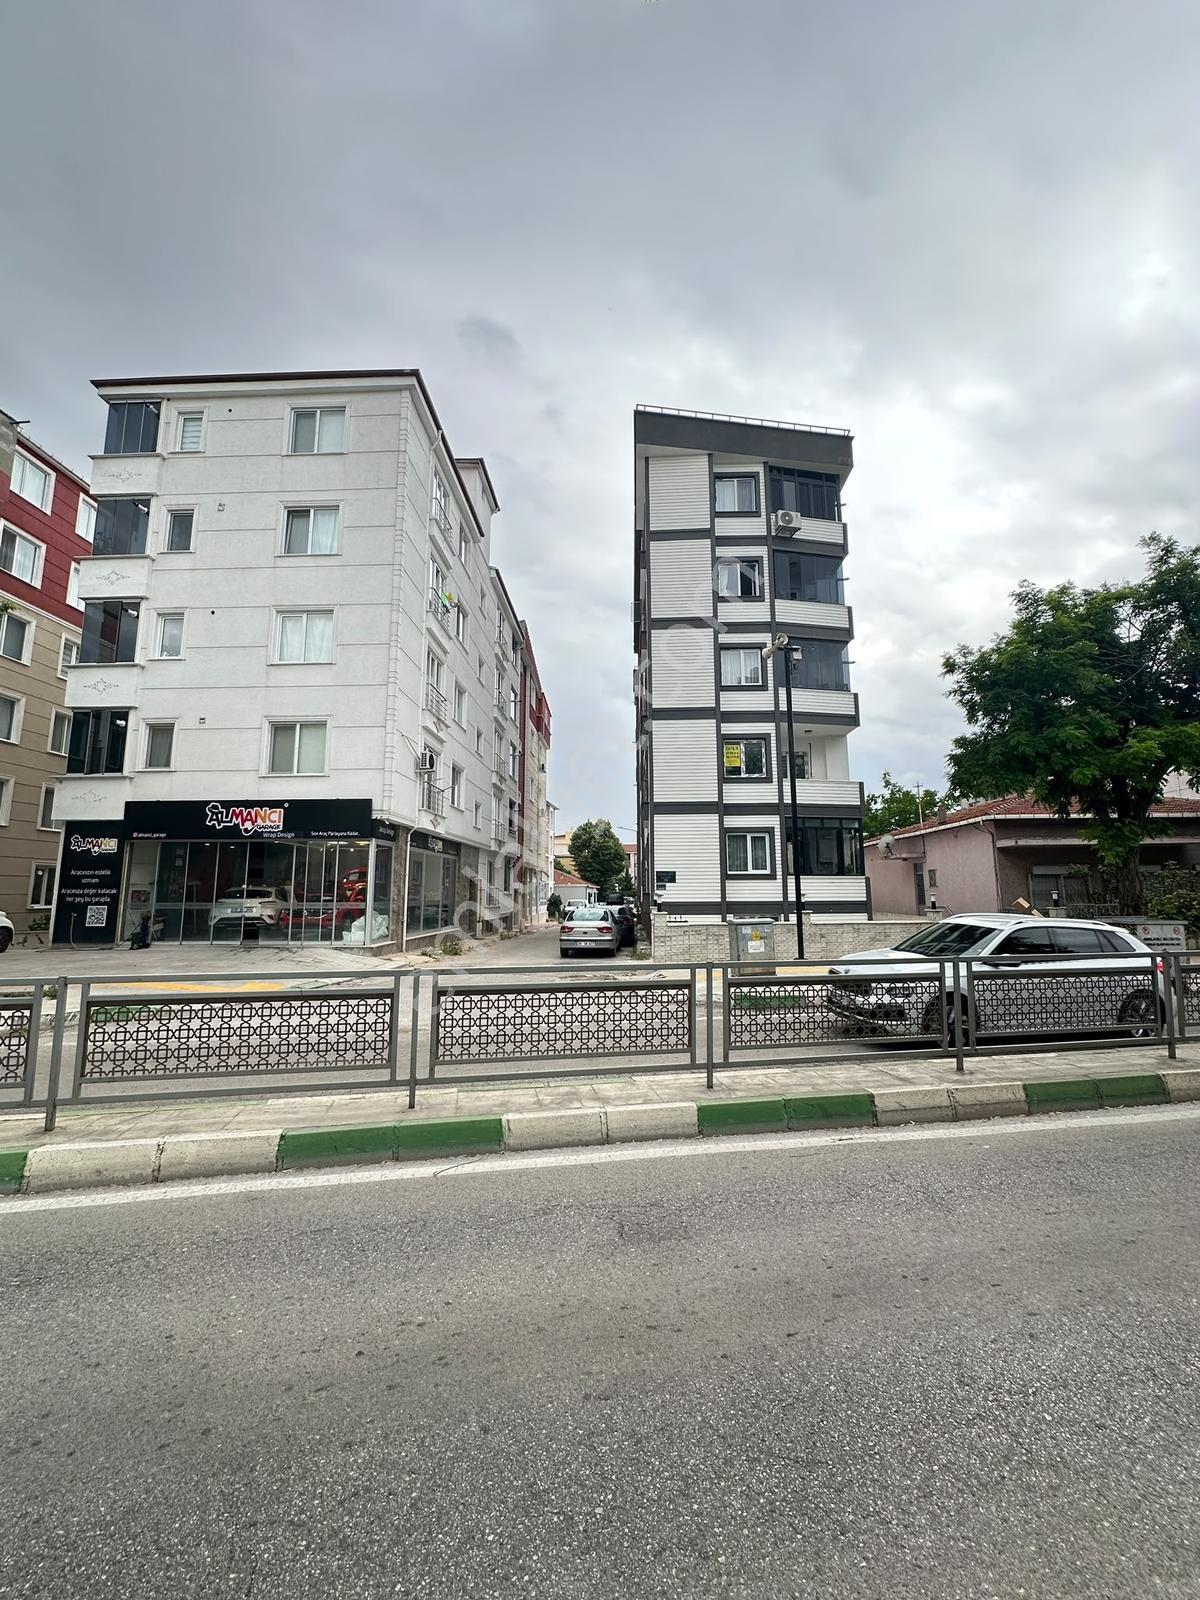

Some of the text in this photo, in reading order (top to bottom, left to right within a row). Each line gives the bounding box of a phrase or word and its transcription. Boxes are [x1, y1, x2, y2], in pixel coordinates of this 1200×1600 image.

[206, 803, 284, 829] ALMANCI
[263, 831, 295, 839] Wrap Design
